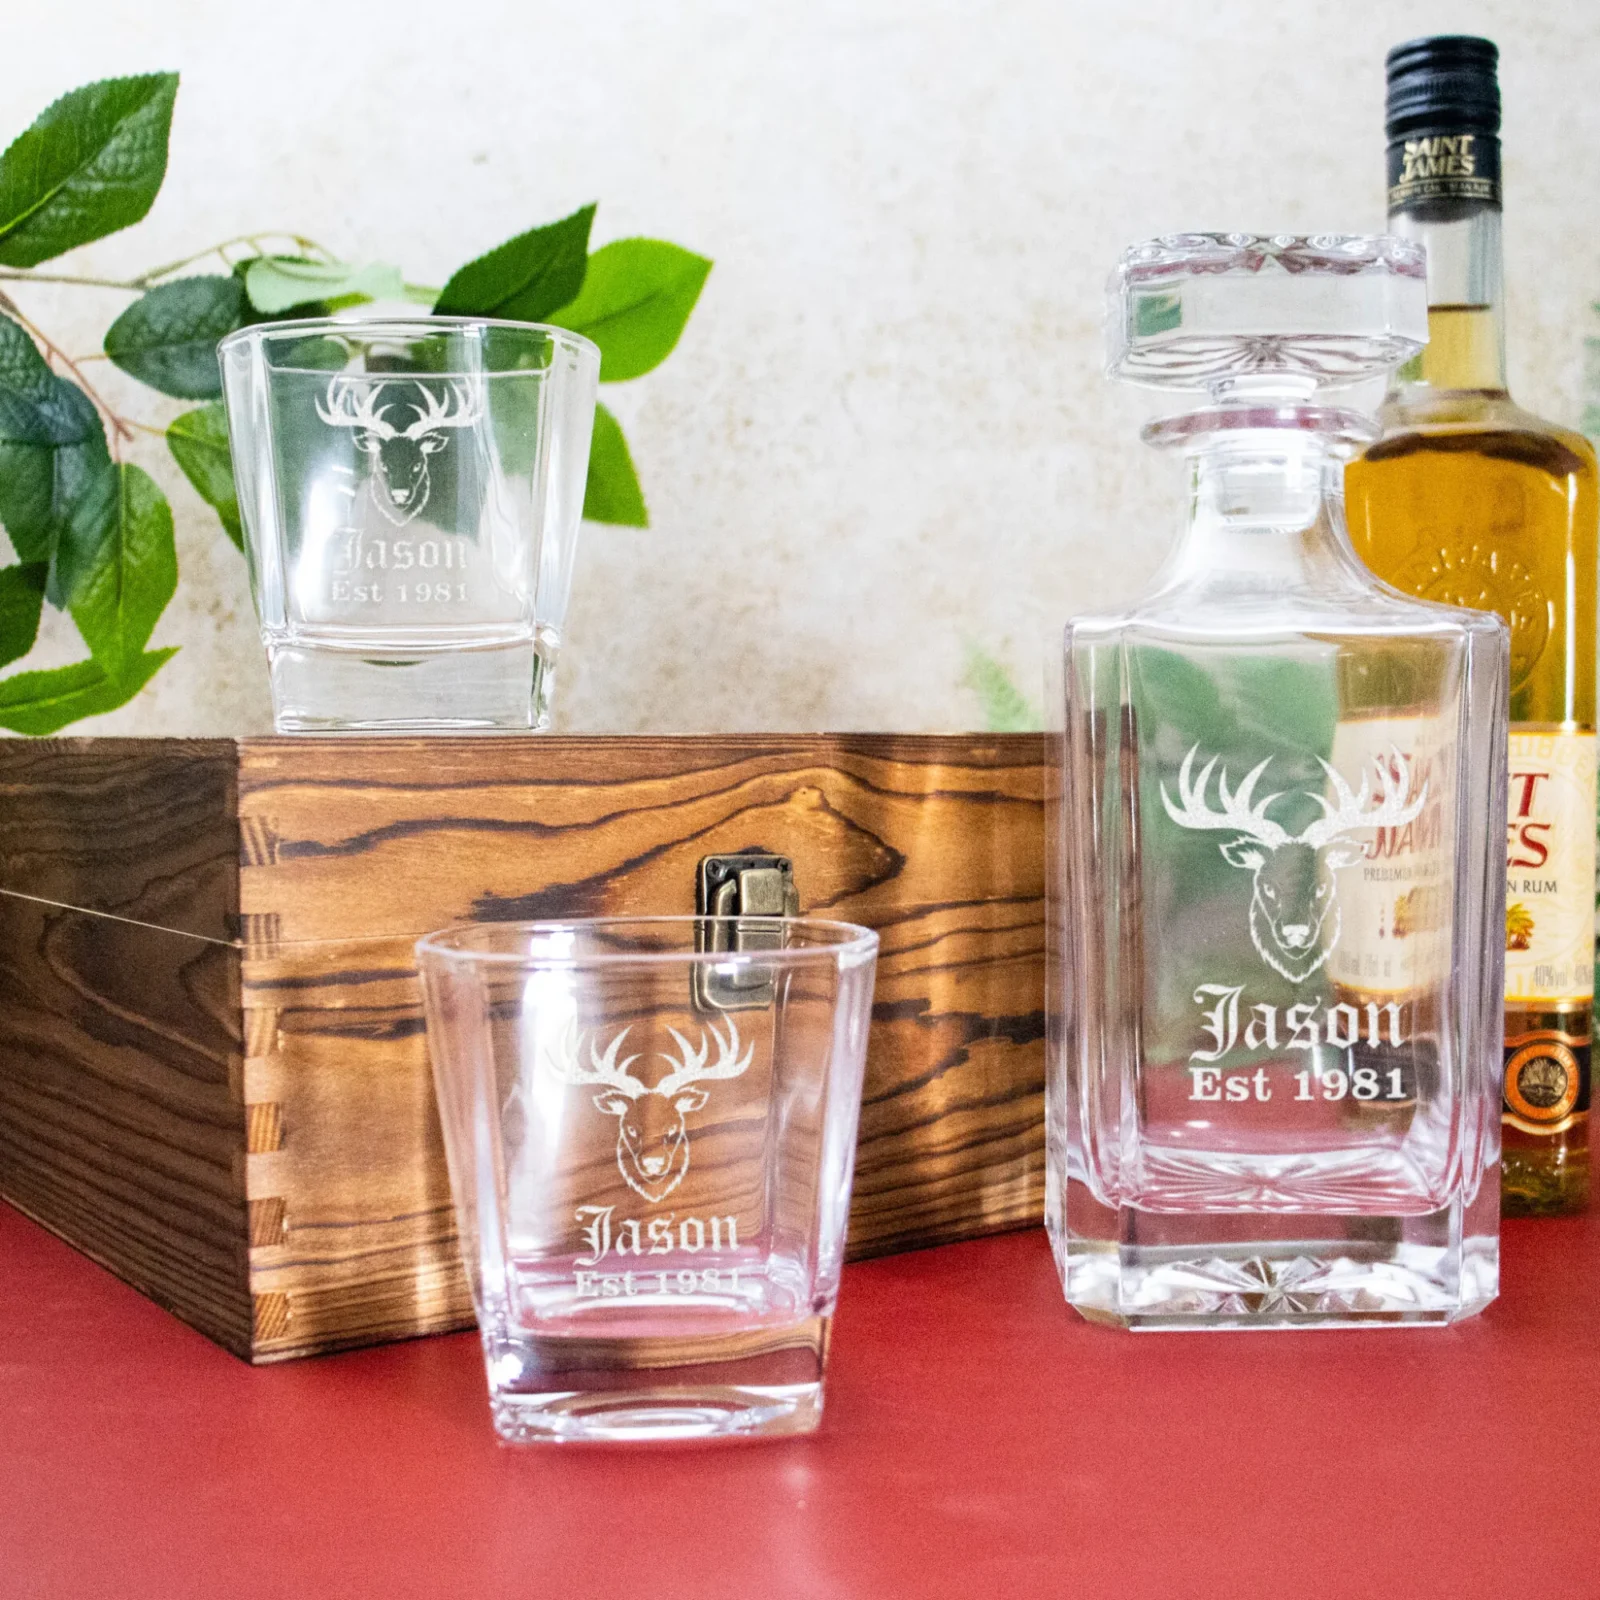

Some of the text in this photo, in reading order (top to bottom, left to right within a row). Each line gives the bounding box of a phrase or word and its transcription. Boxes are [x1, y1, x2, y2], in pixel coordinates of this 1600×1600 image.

[1404, 134, 1474, 157] SAINT
[1398, 154, 1474, 183] JAMES
[332, 527, 467, 575] Jason
[332, 580, 469, 602] Est 1981
[1523, 880, 1558, 893] RUM
[1188, 983, 1405, 1062] Jason
[1188, 1067, 1407, 1101] Est 1981
[573, 1205, 740, 1266] Jason
[573, 1267, 741, 1297] Est 1981
